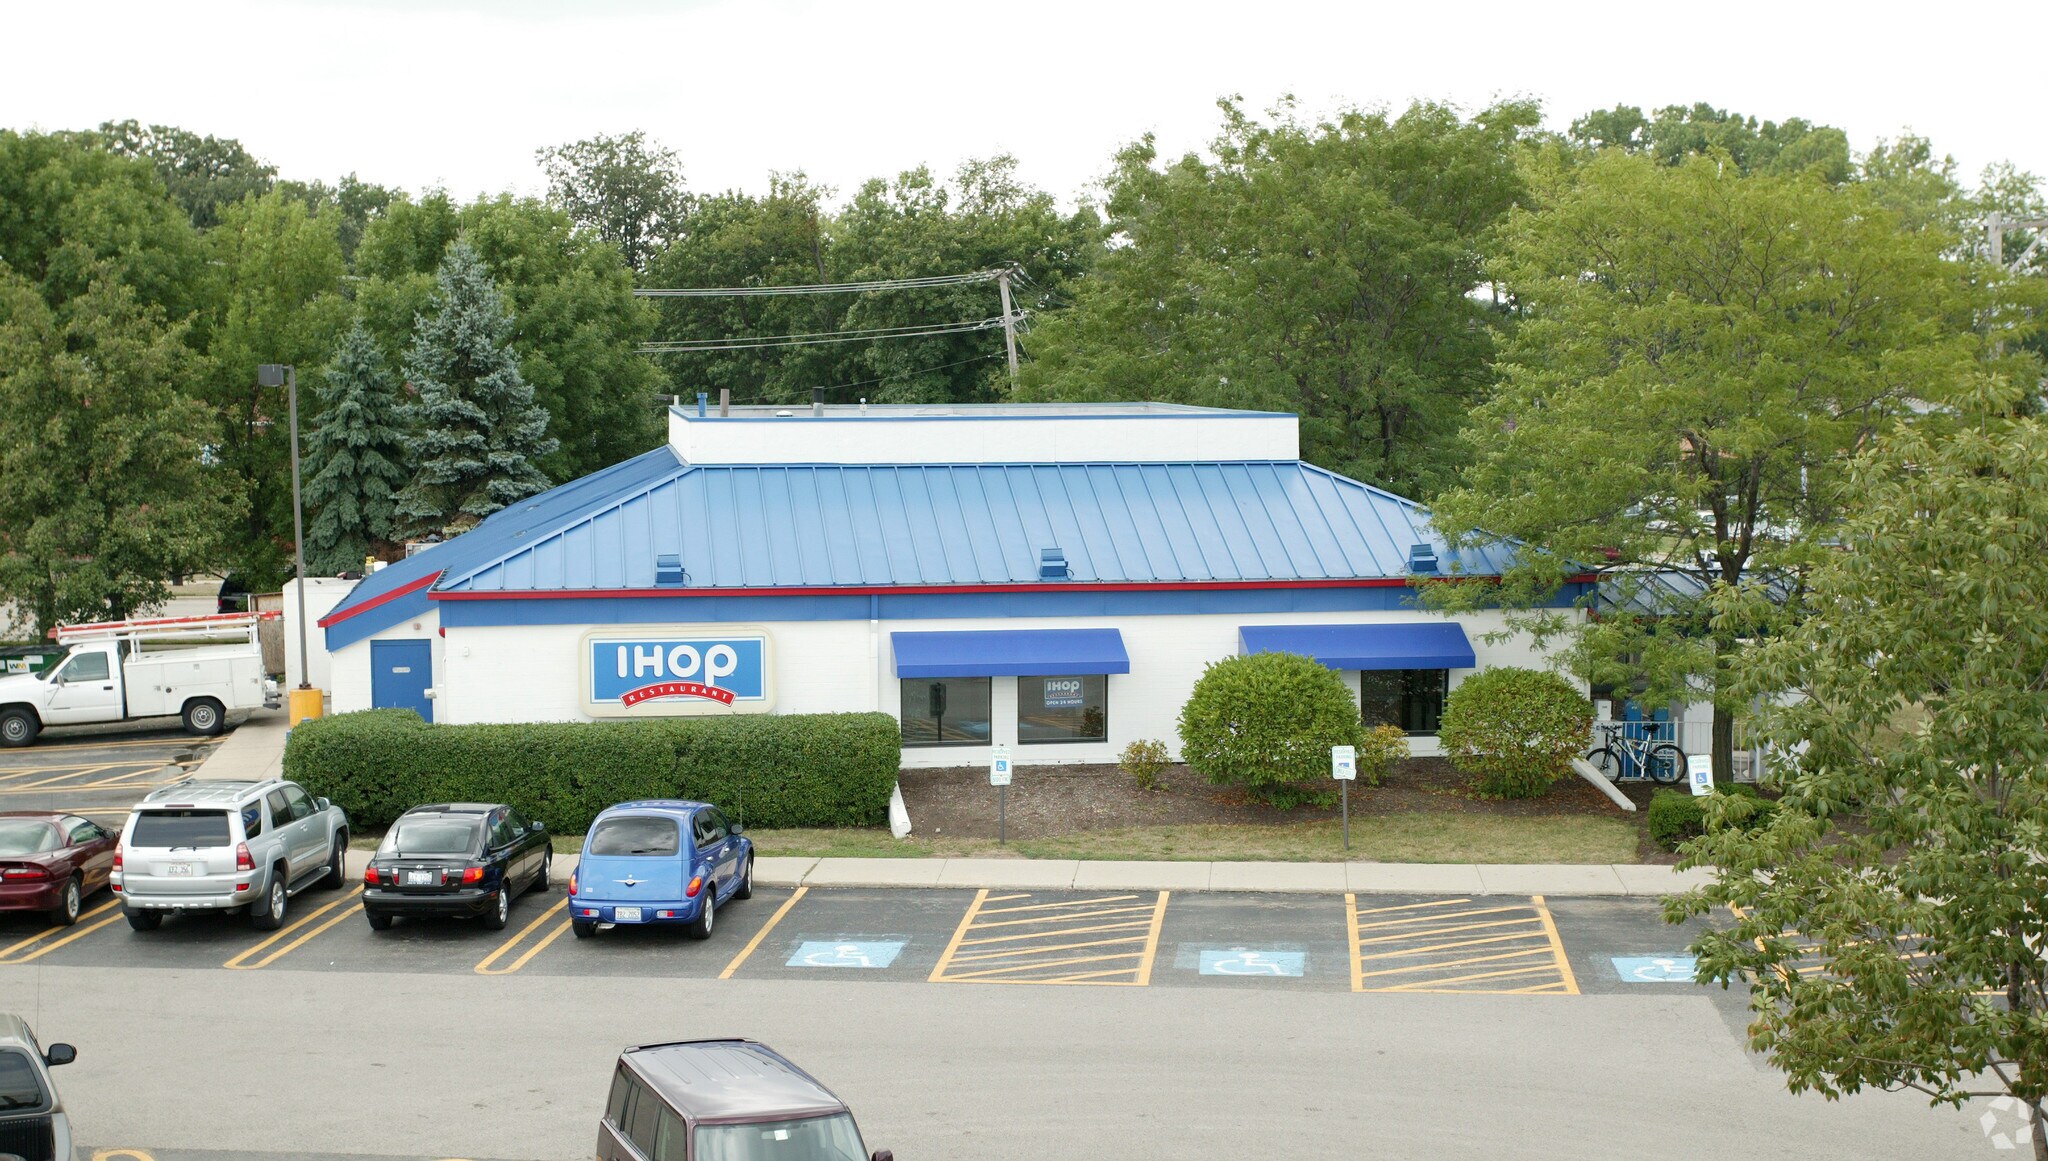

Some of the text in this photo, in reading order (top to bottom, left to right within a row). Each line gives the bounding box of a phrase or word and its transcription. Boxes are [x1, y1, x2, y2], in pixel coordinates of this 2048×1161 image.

[617, 644, 738, 688] IHOP
[628, 685, 728, 702] RESTAURANT
[1047, 680, 1080, 693] IHOP
